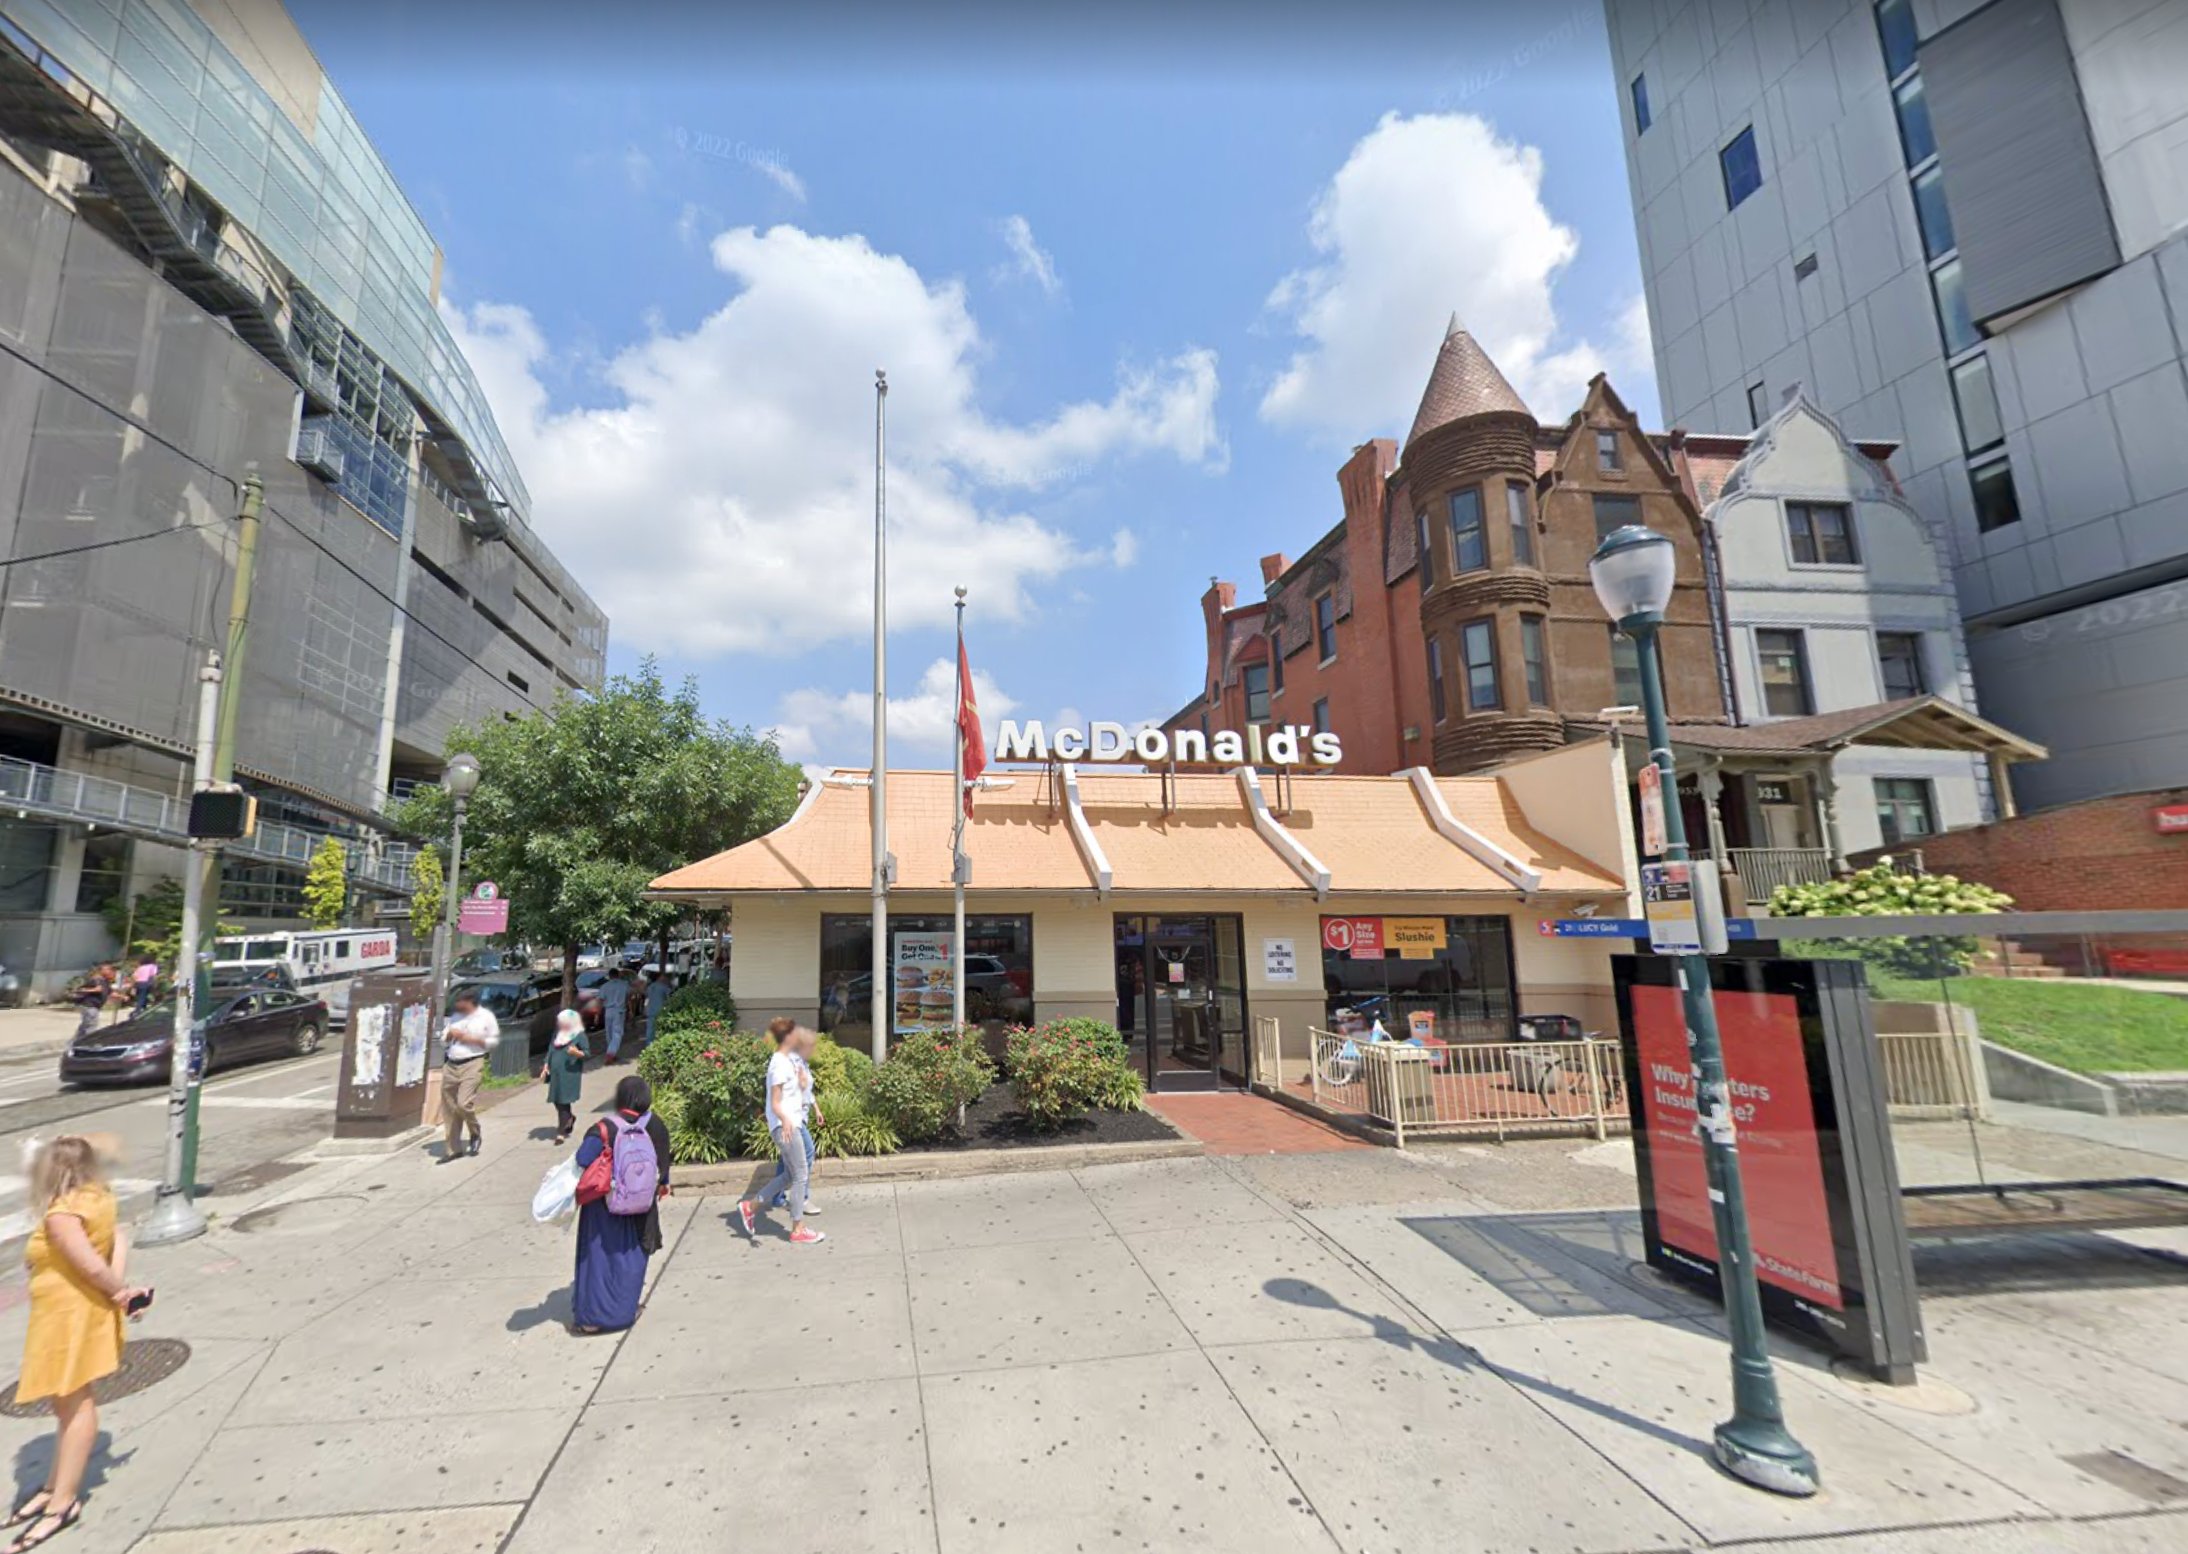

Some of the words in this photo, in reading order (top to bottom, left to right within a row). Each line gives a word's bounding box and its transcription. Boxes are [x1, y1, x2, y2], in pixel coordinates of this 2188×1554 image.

[994, 720, 1343, 765] McDonald's
[1647, 886, 1662, 902] 21
[1356, 922, 1373, 932] Any
[1330, 924, 1350, 945] $1
[1356, 931, 1375, 939] Size
[1395, 932, 1435, 942] Slushie
[360, 939, 391, 960] GARDA
[901, 944, 917, 953] Buy
[901, 953, 916, 961] Get
[1651, 1063, 1689, 1090] Why
